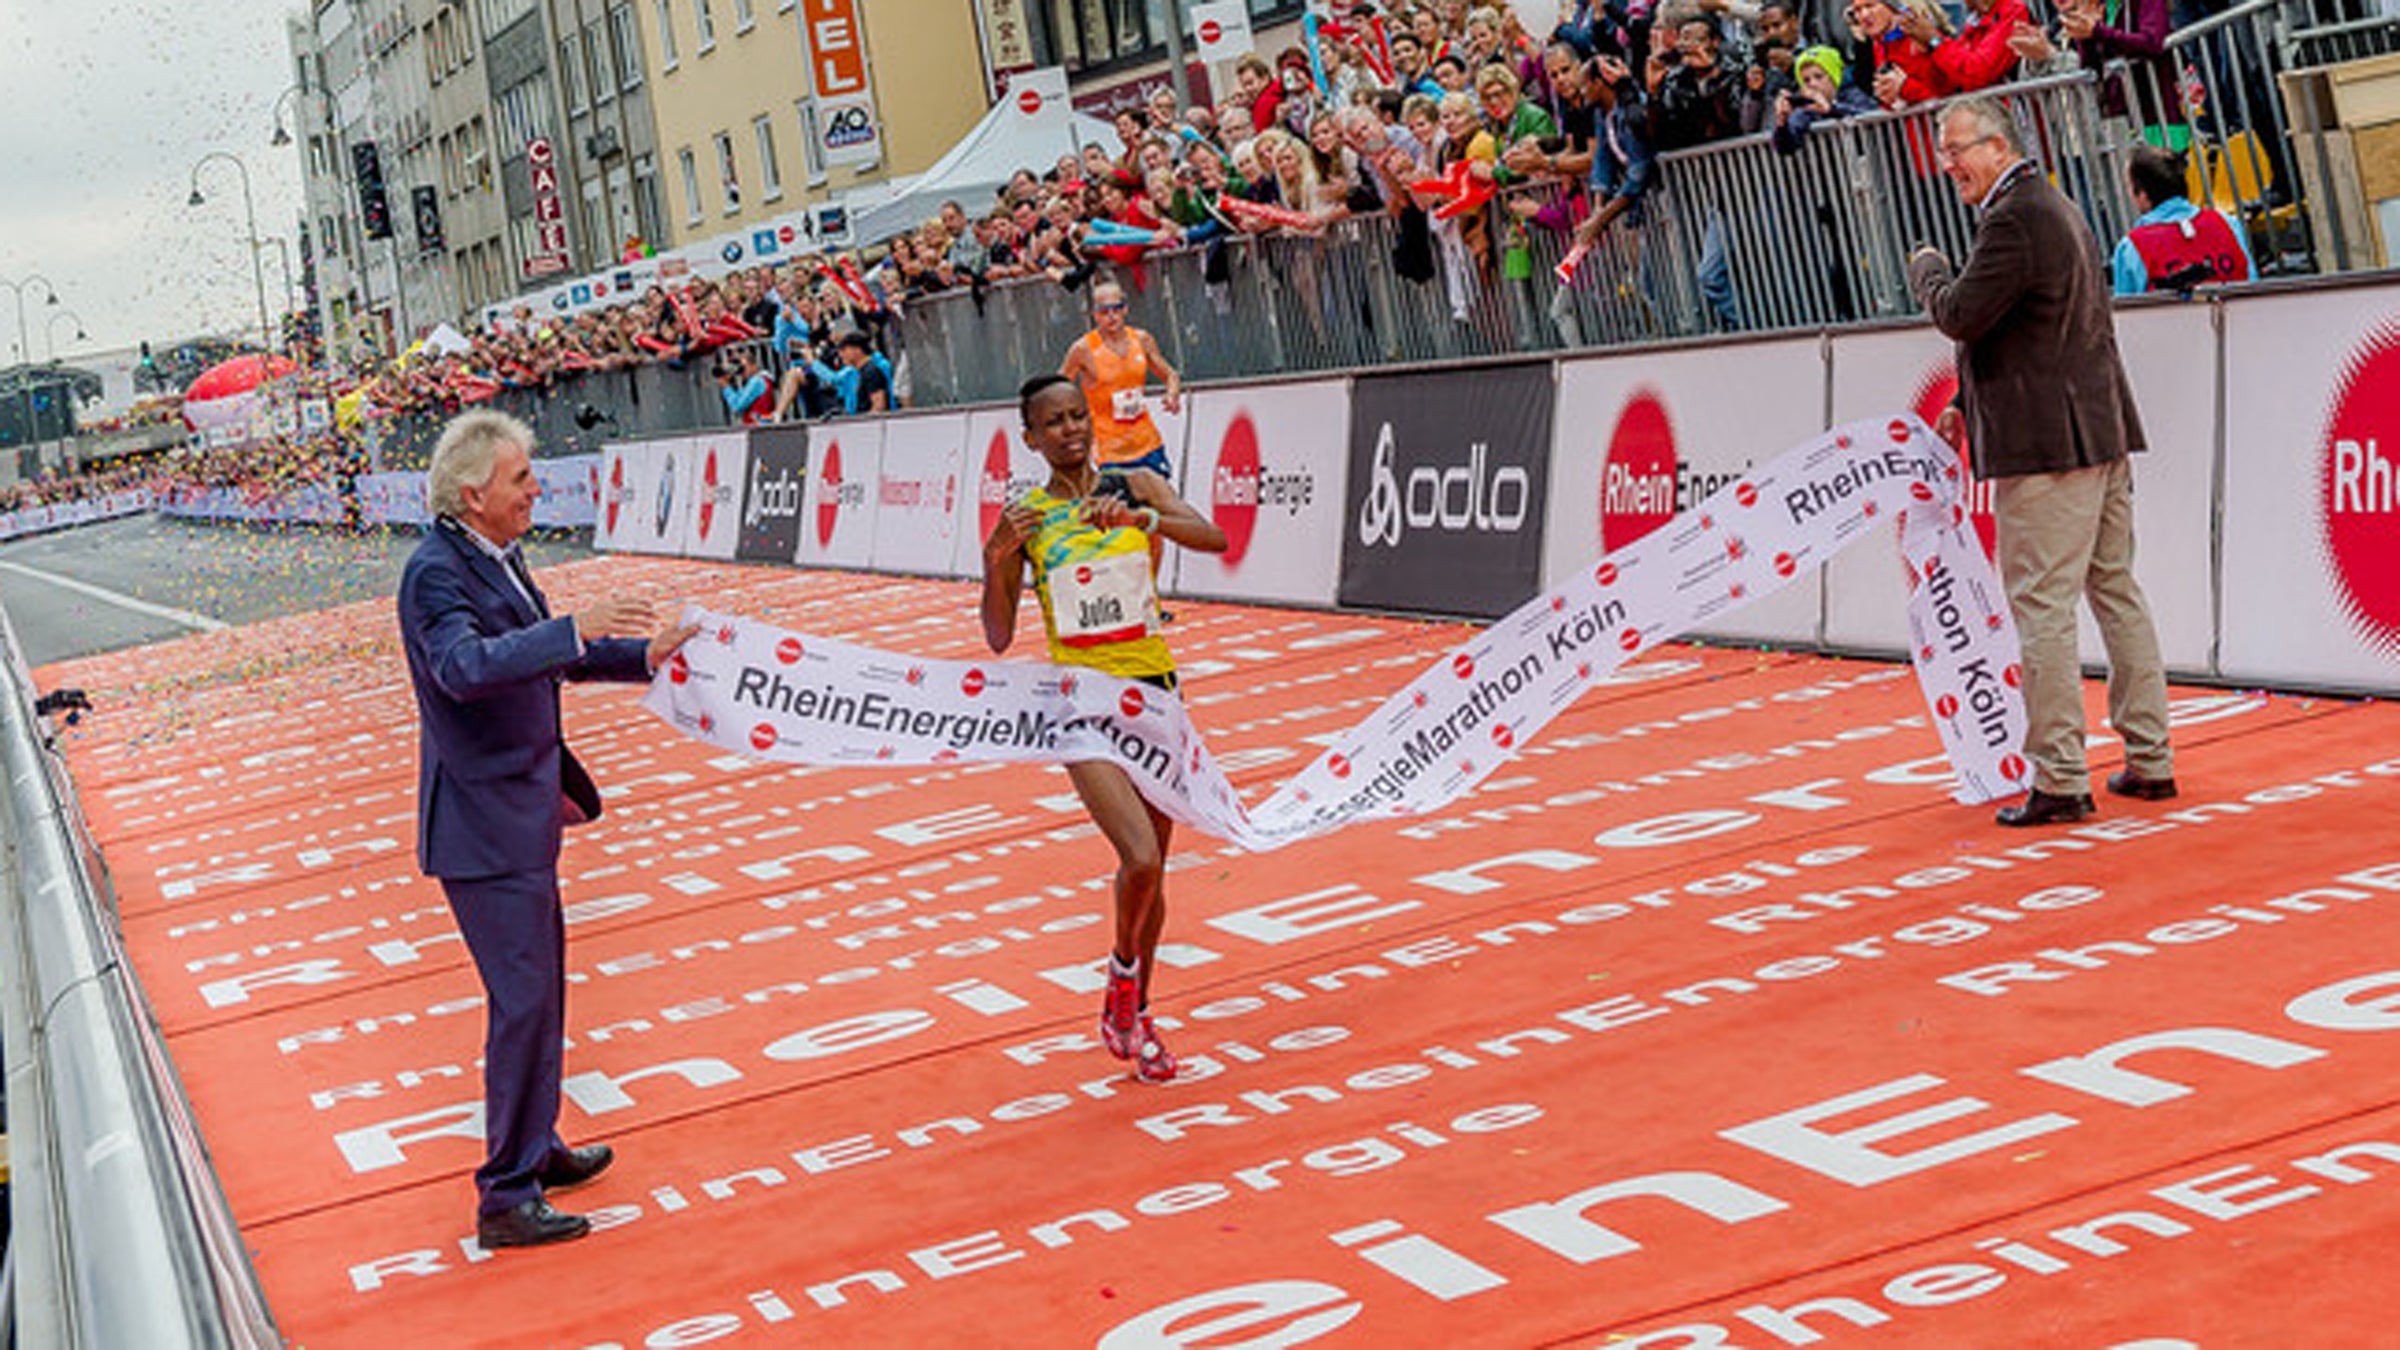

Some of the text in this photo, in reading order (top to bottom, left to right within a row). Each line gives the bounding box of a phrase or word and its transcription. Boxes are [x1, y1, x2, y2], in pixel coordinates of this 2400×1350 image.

[815, 0, 857, 89] EL
[1405, 442, 1529, 532] odlo
[2335, 438, 2400, 513] Rh
[1077, 597, 1125, 628] Julia
[1546, 599, 1627, 660] Köln
[1929, 556, 2010, 748] thon Köln
[1003, 846, 1868, 1065] ReinEnergie
[1135, 886, 2103, 1141] RheinEnergie
[582, 1104, 1544, 1350] einEnergie
